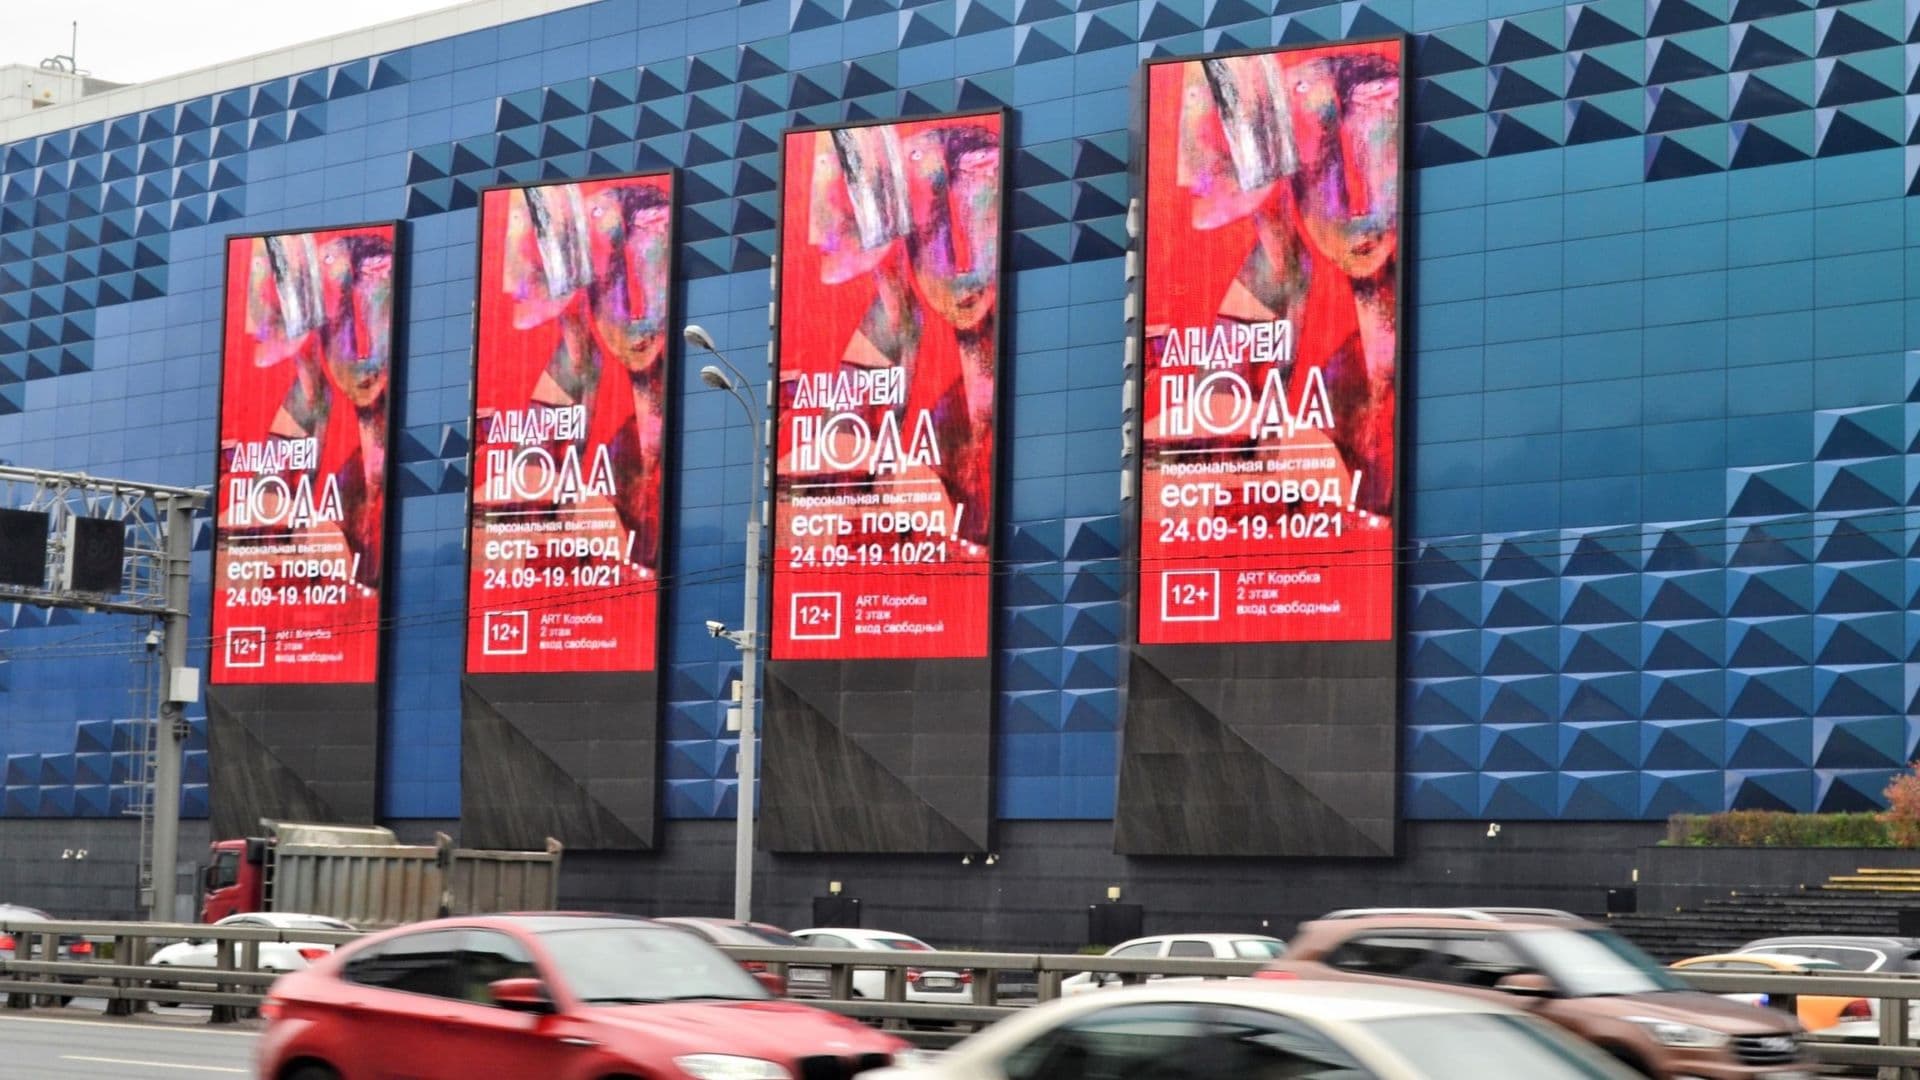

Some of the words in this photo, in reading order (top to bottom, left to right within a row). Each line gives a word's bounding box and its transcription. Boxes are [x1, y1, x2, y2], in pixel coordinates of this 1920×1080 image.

[1160, 366, 1335, 439] НОДА
[791, 409, 942, 475] НОДА
[485, 443, 617, 504] НОДА
[1160, 460, 1263, 477] персональная
[1266, 457, 1336, 471] выставка
[227, 473, 344, 529] НОДА
[792, 495, 879, 509] персональная
[882, 492, 941, 504] выставка
[1160, 483, 1232, 508] есть
[486, 522, 562, 535] персональная
[791, 513, 852, 536] есть
[1159, 513, 1342, 543] 24.09-19.10/21
[485, 539, 539, 560] есть
[789, 542, 946, 568] 24.09-19.10/21
[227, 561, 275, 580] есть
[483, 565, 620, 590] 24.09-19.10/21
[1237, 572, 1264, 584] ART
[1268, 570, 1320, 587] Коробка
[226, 586, 346, 607] 24.09-19.10/21
[1171, 583, 1209, 605] 12+
[1237, 587, 1245, 600] 2
[799, 606, 831, 625] 12+
[856, 608, 862, 620] 2
[491, 623, 520, 641] 12+
[232, 638, 258, 655] 12+
